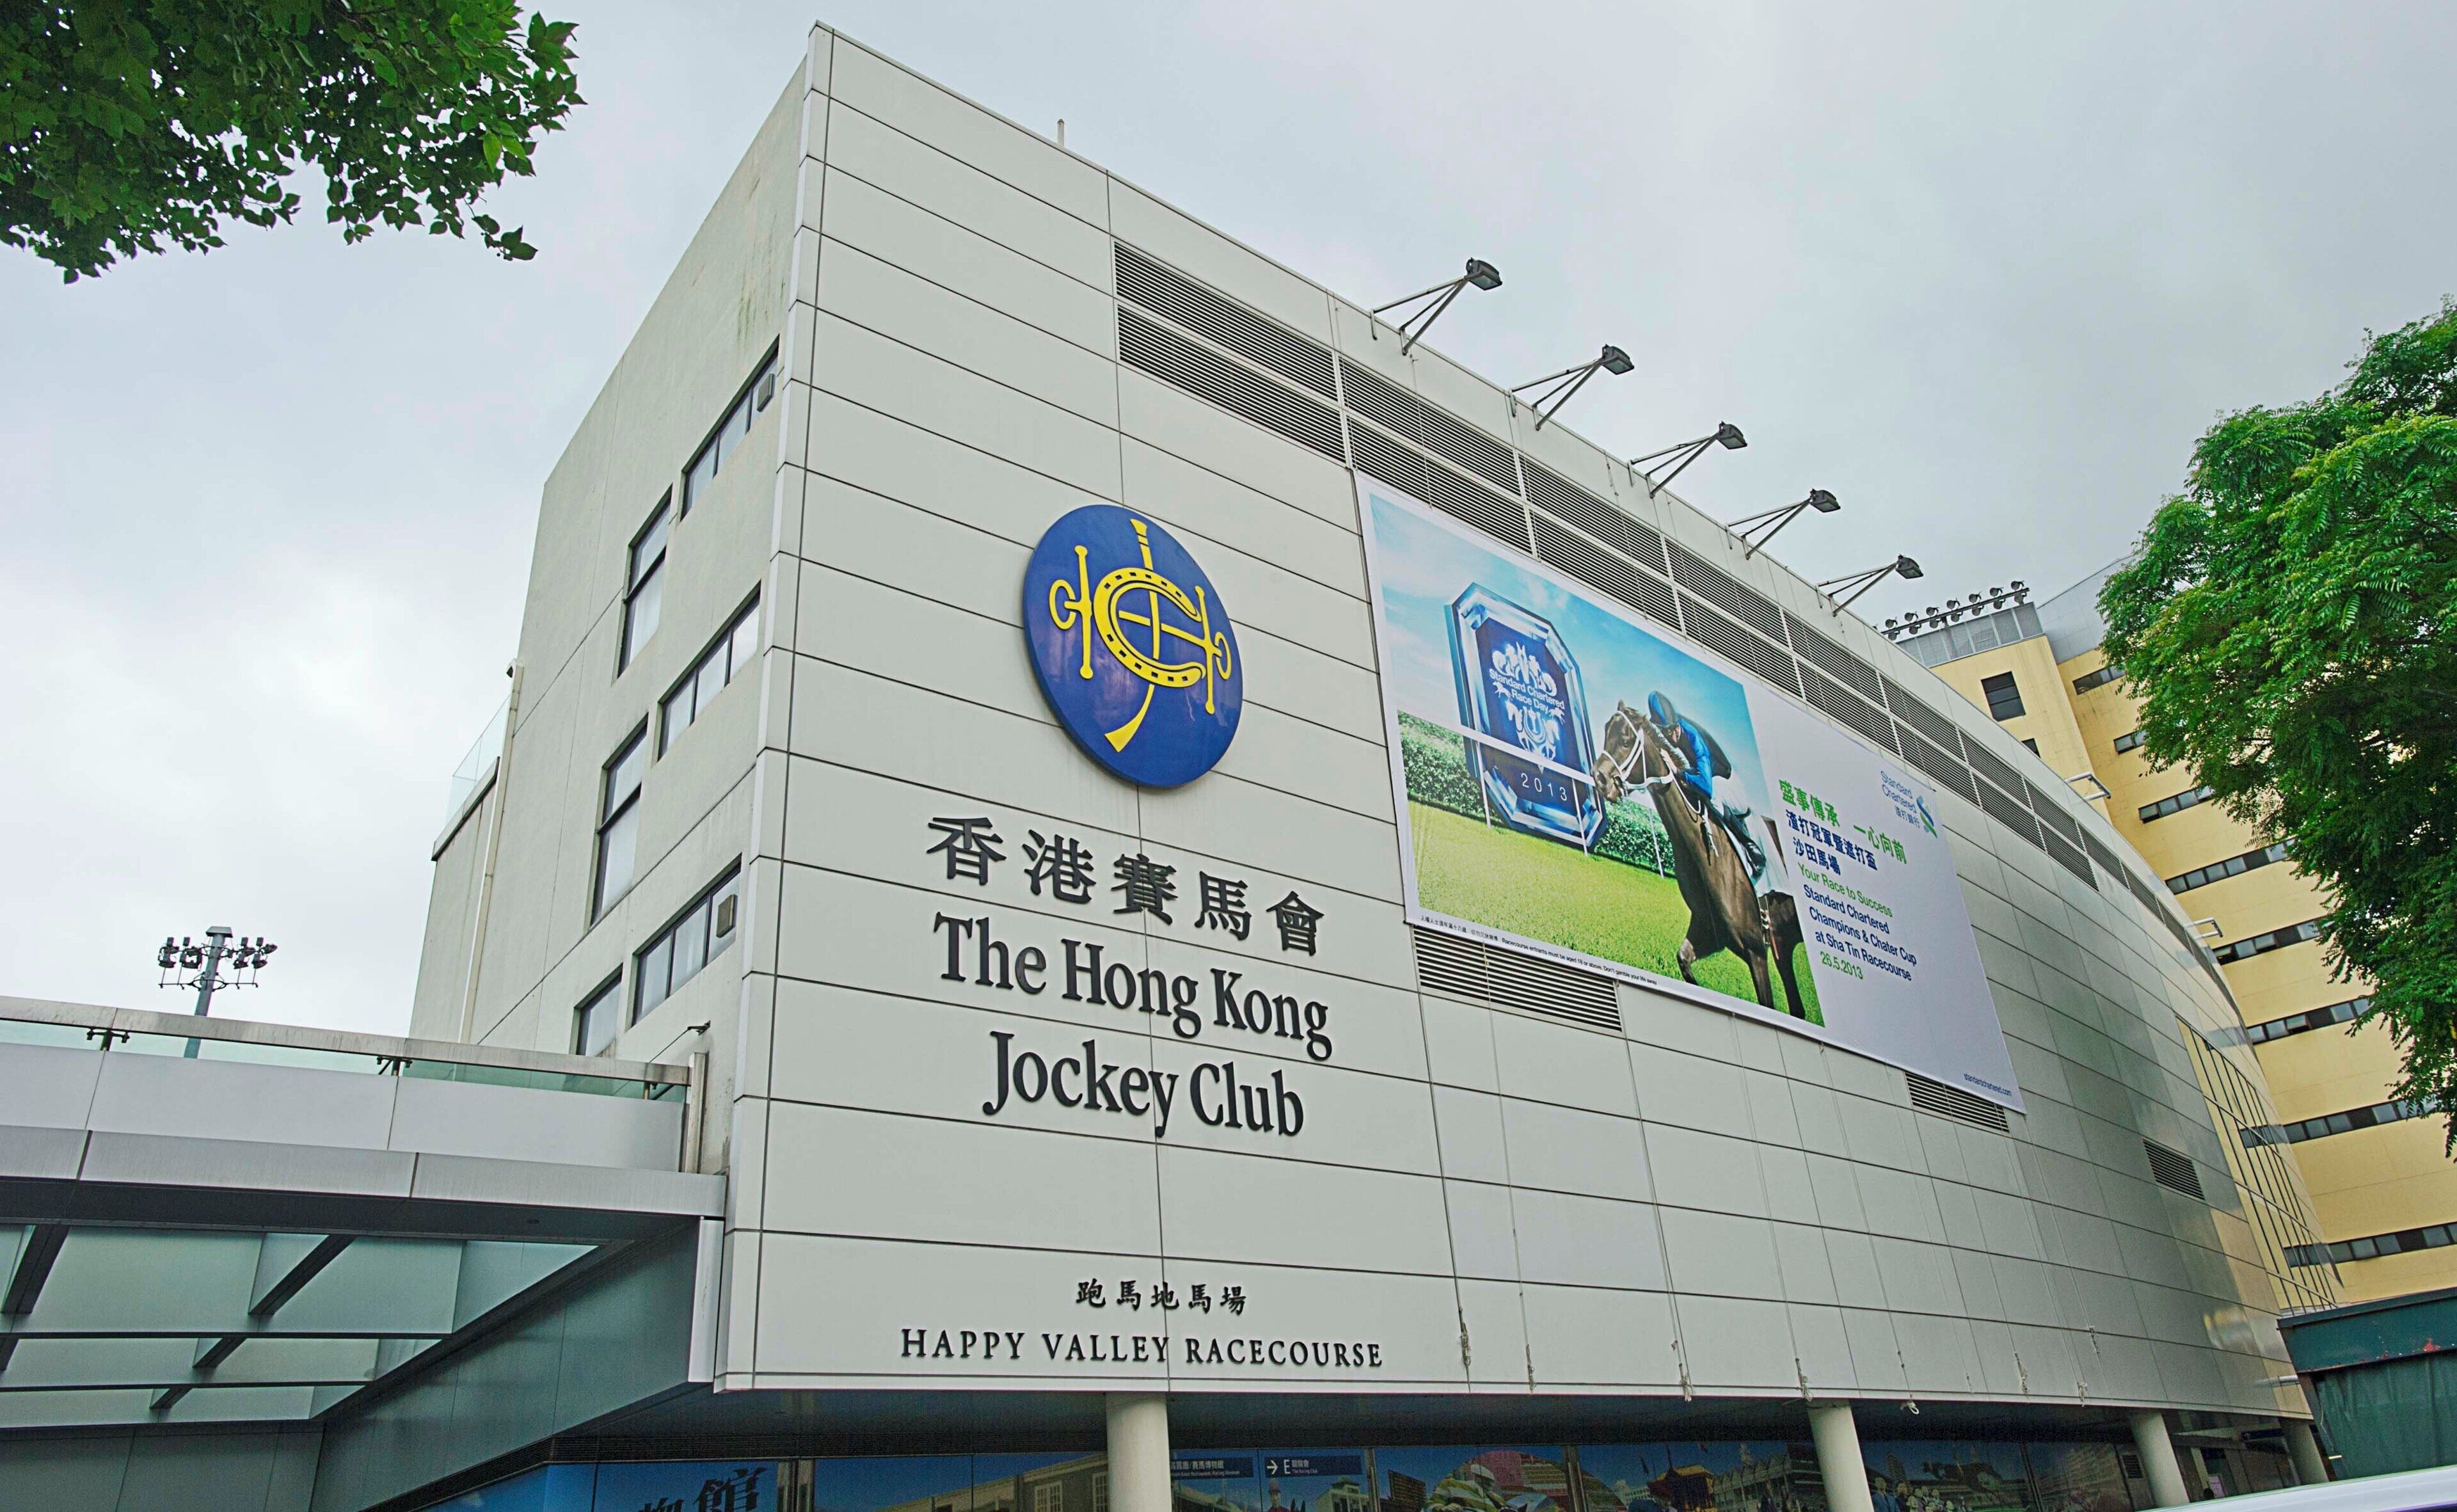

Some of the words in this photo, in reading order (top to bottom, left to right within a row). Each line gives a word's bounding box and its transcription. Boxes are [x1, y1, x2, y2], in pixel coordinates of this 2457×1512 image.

[1489, 668, 1526, 693] Standard
[1527, 682, 1565, 710] Chartered
[1511, 688, 1532, 706] Race
[1533, 698, 1549, 714] Day
[1521, 772, 1567, 801] 2013
[1881, 770, 1913, 799] Standard
[1882, 784, 1917, 813] Chartered
[1779, 779, 1840, 827] 盛事傳承
[1853, 824, 1907, 864] 一心向前
[1785, 809, 1878, 871] 渣打冠軍暨遮打盃
[1793, 836, 1841, 875] 沙田馬場
[926, 816, 1324, 957] 香港賽馬會
[1798, 863, 1820, 883] Your
[1822, 873, 1845, 895] Race
[1846, 886, 1856, 900] to
[1857, 890, 1893, 918] Success
[1804, 884, 1845, 914] Standard
[1847, 903, 1890, 934] Chartered
[1809, 906, 1861, 940] Champions
[1862, 930, 1870, 943] &
[1870, 933, 1898, 957] Chater
[1900, 947, 1918, 967] Cup
[1815, 931, 1825, 944] at
[1826, 932, 1845, 953] Sha
[1845, 941, 1861, 959] Tin
[1861, 948, 1912, 981] Racecourse
[934, 911, 1046, 995] The
[1060, 938, 1202, 1039] Hong
[1211, 967, 1333, 1061] Kong
[1820, 951, 1864, 980] 26.5.2013
[982, 1030, 1179, 1138] Jockey
[1189, 1060, 1305, 1137] Club
[1076, 1278, 1247, 1316] 跑馬地馬場
[900, 1328, 1025, 1360] HAPPY
[1042, 1332, 1170, 1364] VALLEY
[1185, 1337, 1383, 1368] RACECOURSE
[1284, 1460, 1291, 1474] E
